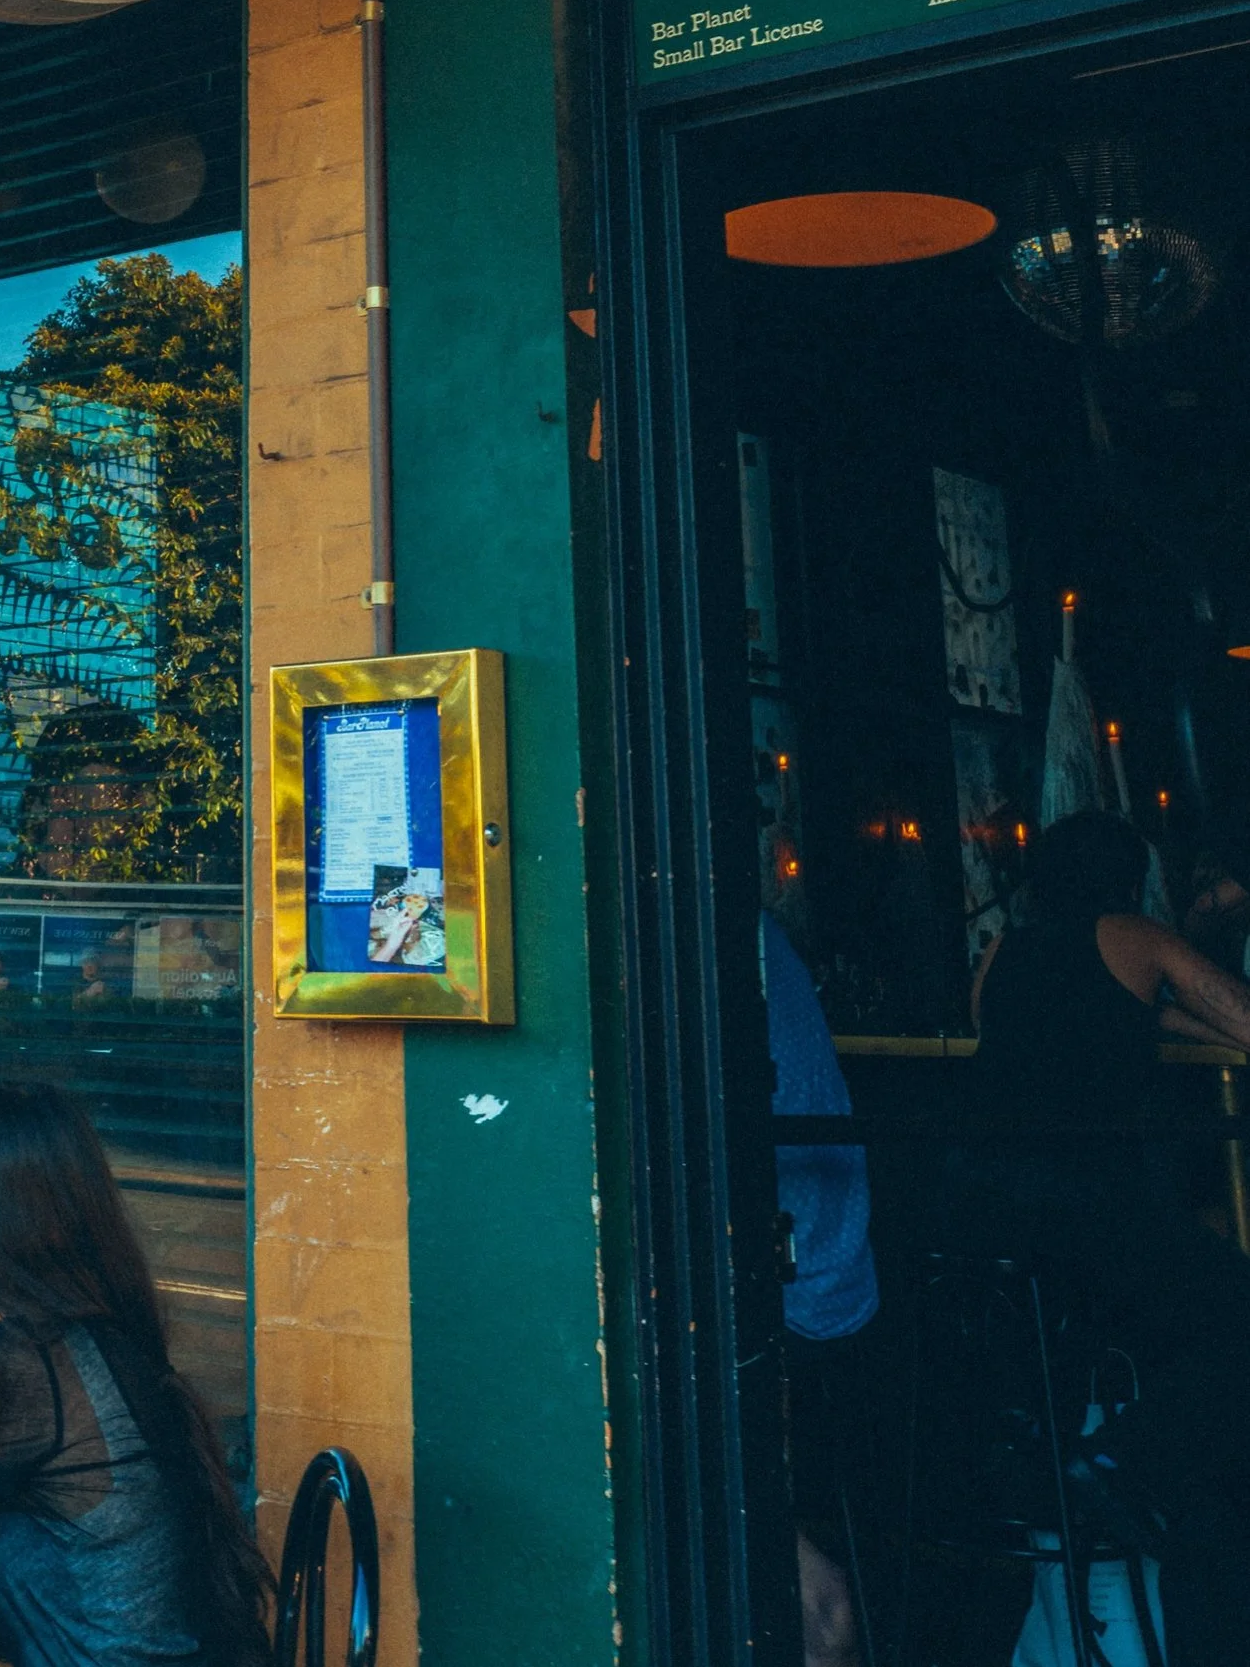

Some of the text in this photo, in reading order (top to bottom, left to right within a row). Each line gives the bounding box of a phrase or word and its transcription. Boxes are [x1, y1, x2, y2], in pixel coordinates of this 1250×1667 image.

[651, 4, 752, 41] Bar Planet
[653, 18, 824, 69] Small Bar License
